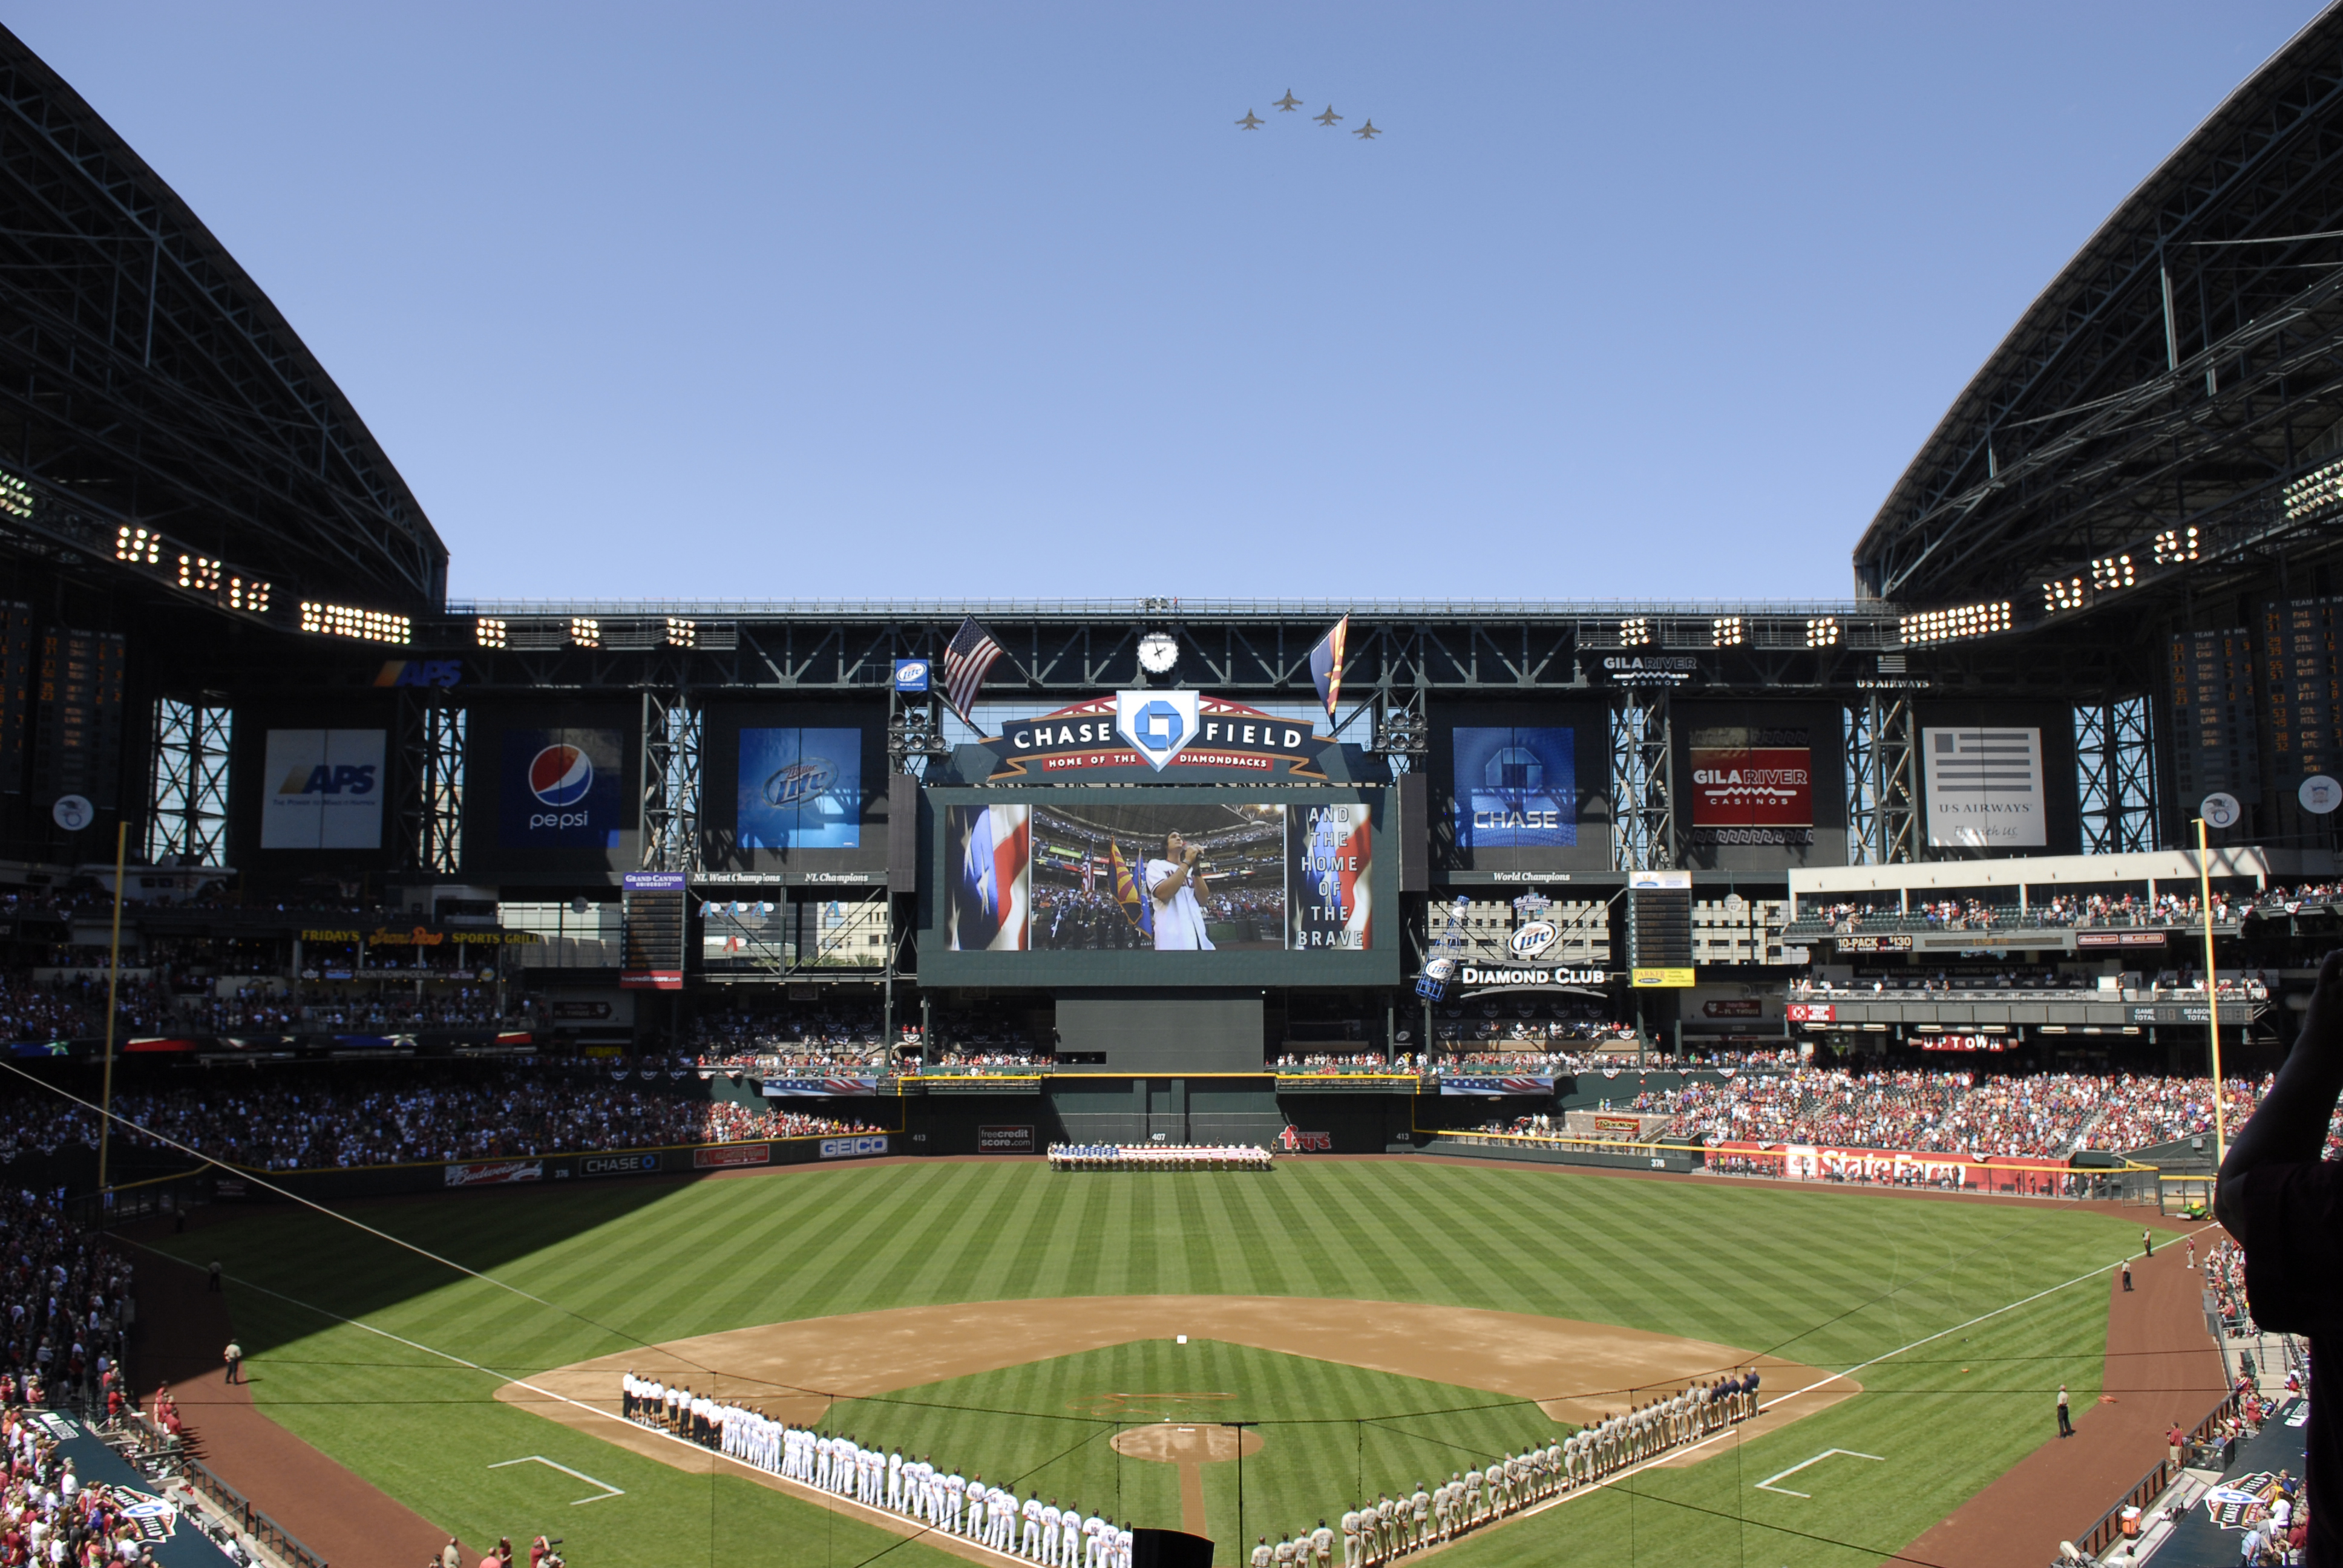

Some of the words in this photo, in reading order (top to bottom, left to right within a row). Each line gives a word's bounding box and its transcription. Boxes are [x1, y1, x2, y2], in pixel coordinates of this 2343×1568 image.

[395, 660, 462, 687] APS
[1014, 724, 1111, 749] CHASE
[1207, 723, 1301, 748] FIELD
[1049, 757, 1082, 768] HOME
[1090, 756, 1106, 765] OF
[1114, 754, 1136, 763] THE
[1180, 754, 1267, 768] DIAMONDBACKS
[301, 765, 376, 794] APS
[775, 771, 828, 806] Lite
[1309, 808, 1348, 822] AND
[1964, 804, 2030, 813] AIRWAYS
[529, 811, 589, 830] pepsi
[1474, 811, 1559, 828] CHASE
[1310, 832, 1348, 847] THE
[1302, 857, 1357, 871] HOME
[693, 874, 707, 882] NL
[709, 874, 730, 882] West
[731, 873, 781, 883] Champions
[805, 873, 819, 882] NL
[819, 873, 868, 883] Champions
[1493, 872, 1520, 881] World
[1521, 872, 1570, 883] Champions
[1319, 881, 1341, 896] OF
[1311, 906, 1349, 921] THE
[451, 933, 500, 944] SPORTS
[1297, 930, 1363, 946] BRAVE
[1519, 931, 1551, 951] Lite
[1838, 938, 1878, 947] 10-PACK
[1889, 936, 1912, 947] $130
[1463, 968, 1549, 984] DIAMOND
[1555, 967, 1605, 984] CLUB
[1634, 970, 1666, 979] PARKER
[1923, 1034, 2001, 1050] UPTOWN
[981, 1129, 1029, 1138] freecredit
[1279, 1125, 1330, 1151] fry's
[821, 1137, 887, 1156] GEICO
[981, 1138, 1031, 1146] score.com
[586, 1157, 639, 1172] CHASE
[1651, 1158, 1665, 1168] 376
[1821, 1149, 1891, 1180] State
[1894, 1154, 1966, 1185] Farm
[459, 1160, 526, 1184] Budweiser
[2240, 1476, 2269, 1493] FIELD
[2221, 1503, 2241, 1523] CHASE
[140, 1517, 163, 1537] FIELD
